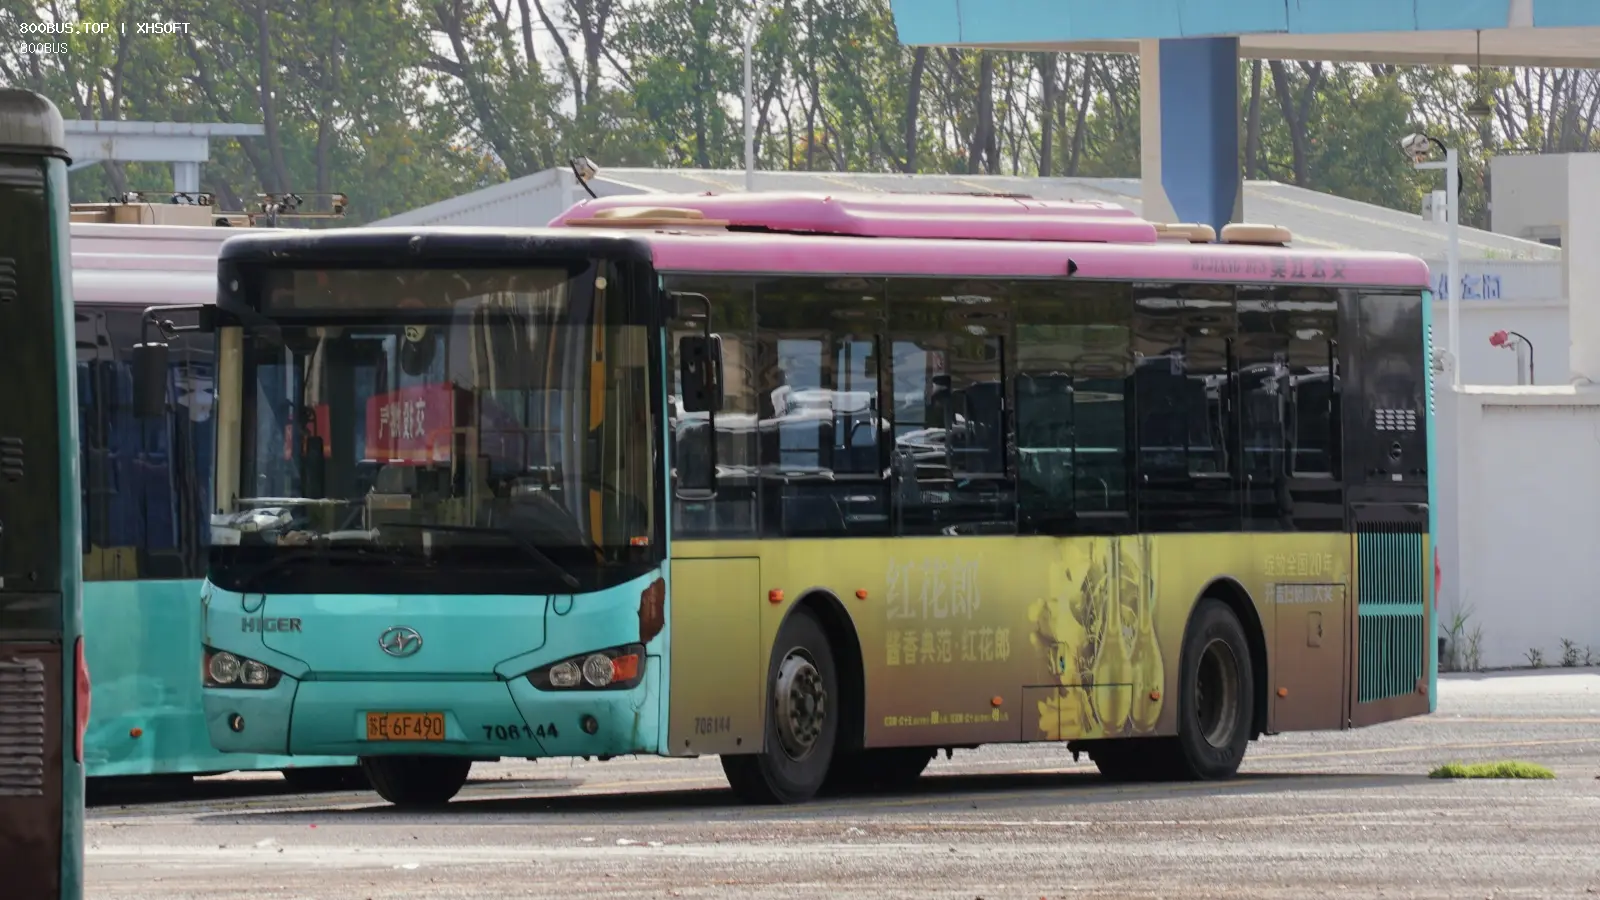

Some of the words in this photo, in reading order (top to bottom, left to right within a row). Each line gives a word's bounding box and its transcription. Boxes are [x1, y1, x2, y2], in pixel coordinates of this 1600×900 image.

[1270, 254, 1348, 279] 吴江公交
[886, 555, 982, 621] 红花郎
[241, 617, 303, 633] HIGER
